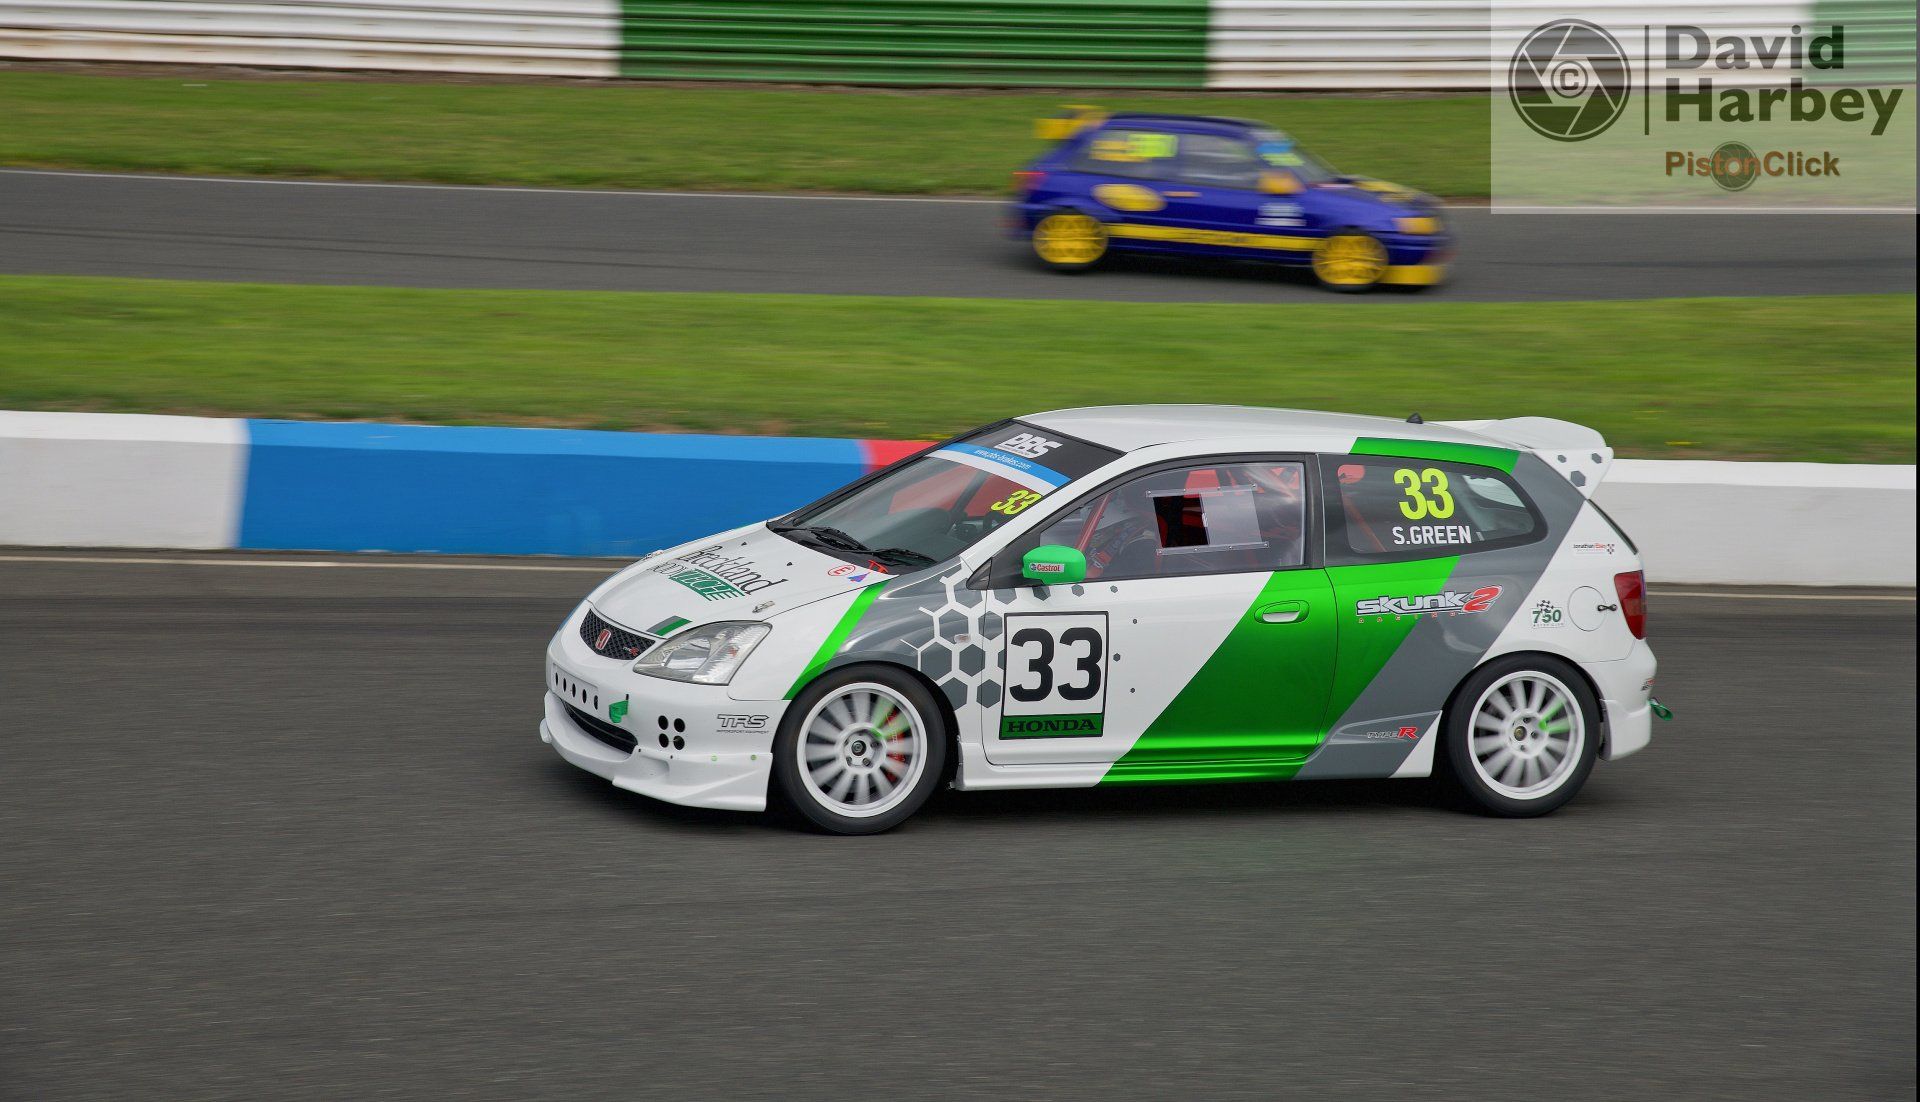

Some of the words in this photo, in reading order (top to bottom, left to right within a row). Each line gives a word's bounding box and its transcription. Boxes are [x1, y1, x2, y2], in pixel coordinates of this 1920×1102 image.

[991, 489, 1042, 515] 33
[1393, 468, 1455, 520] 33
[1392, 525, 1472, 545] S.GREEN
[1036, 563, 1061, 572] Castrol
[1532, 609, 1562, 624] 750
[1009, 627, 1103, 702] 33
[717, 713, 769, 729] TRS
[1005, 719, 1097, 733] HONDA
